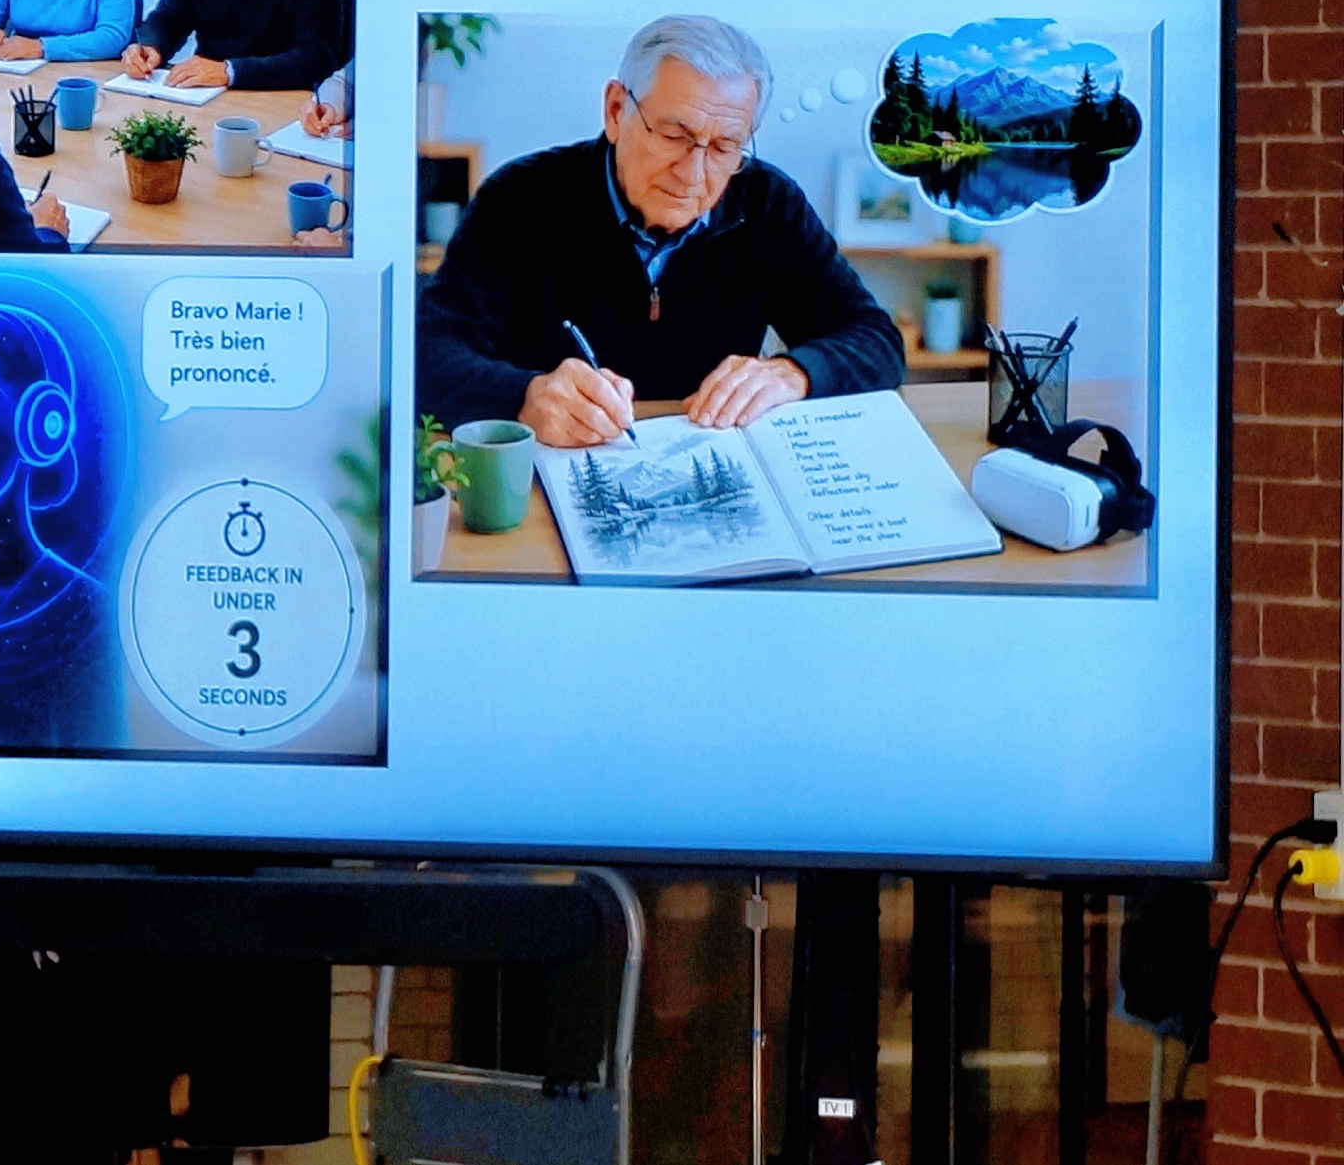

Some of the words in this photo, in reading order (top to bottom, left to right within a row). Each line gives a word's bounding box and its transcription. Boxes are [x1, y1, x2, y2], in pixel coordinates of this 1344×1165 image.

[171, 300, 228, 319] Bravo
[235, 301, 291, 320] Marie
[170, 330, 214, 349] Très
[221, 330, 265, 351] bien
[170, 362, 276, 387] prononcé.
[186, 565, 279, 584] FEEDBACK
[285, 567, 303, 584] IN
[213, 591, 276, 611] UNDER
[225, 619, 261, 679] 3
[198, 688, 287, 706] SECONDS
